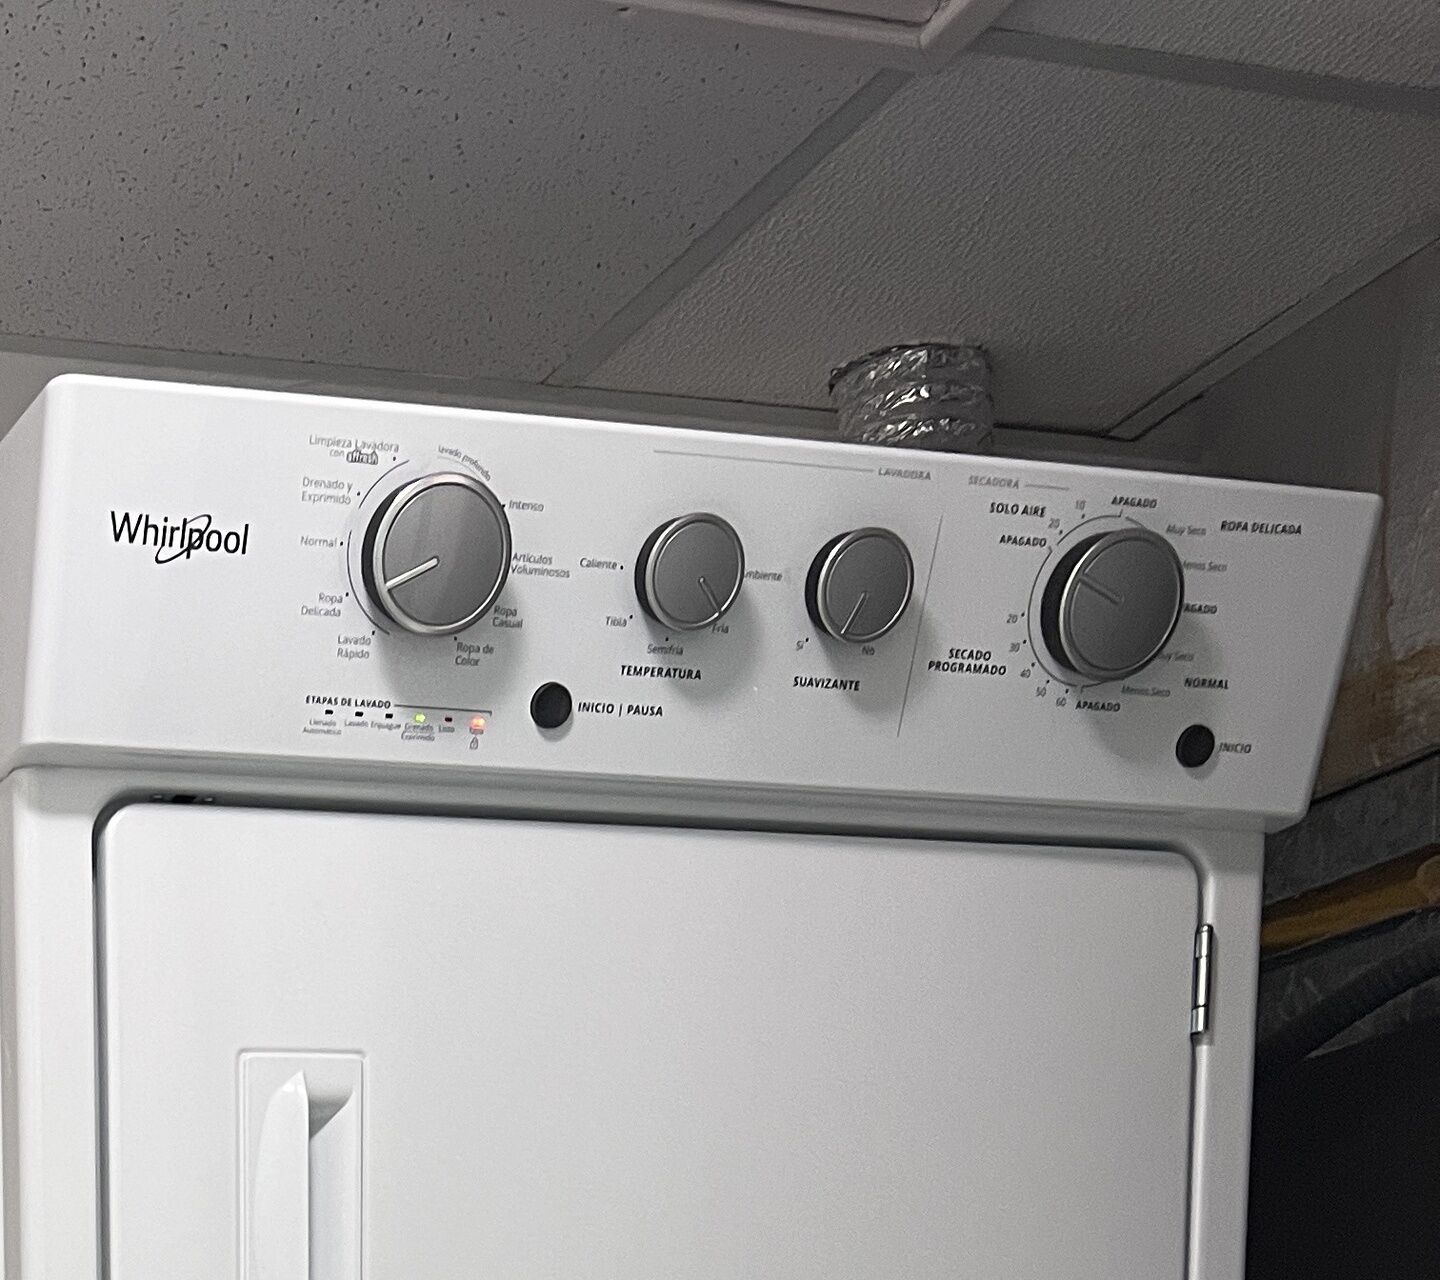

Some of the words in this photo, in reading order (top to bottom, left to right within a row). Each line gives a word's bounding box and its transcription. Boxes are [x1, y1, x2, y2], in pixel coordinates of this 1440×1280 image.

[309, 433, 353, 449] Limpieza
[355, 437, 400, 452] Lavadora
[302, 476, 345, 490] Drenado
[346, 481, 354, 494] y
[968, 475, 1020, 490] SECADORA
[301, 492, 352, 505] Exprimido
[1111, 495, 1158, 509] APAGADO
[509, 500, 545, 512] Intenso
[989, 502, 1020, 516] SOLO
[1021, 504, 1047, 518] AIRE
[1048, 517, 1060, 529] 20
[1220, 520, 1249, 533] ROPA
[1251, 522, 1303, 535] DELICADA
[110, 510, 250, 565] Whirlpool
[300, 535, 338, 548] Normal
[999, 534, 1048, 548] APAGADO
[579, 557, 618, 570] Caliente
[511, 564, 571, 579] Voluminosos
[744, 568, 783, 582] mbiente
[318, 592, 343, 605] Ropa
[300, 606, 342, 617] Delicada
[493, 605, 517, 618] Ropa
[1183, 602, 1218, 615] AGADO
[492, 617, 524, 629] Casual
[1006, 613, 1018, 624] 20
[337, 634, 372, 647] Lavado
[456, 642, 480, 656] Ropa
[482, 643, 495, 654] de
[948, 647, 992, 661] SECADO
[454, 655, 481, 666] Color
[620, 664, 702, 680] TEMPERATURA
[927, 660, 1008, 676] PROGRAMADO
[792, 676, 861, 691] SUAVIZANTE
[1184, 677, 1230, 690] NORMAL
[305, 694, 339, 706] ETAPAS
[340, 696, 353, 707] DE
[354, 698, 391, 709] LAVADO
[1075, 700, 1121, 713] APAGADO
[577, 701, 615, 715] INICIO
[626, 703, 664, 717] PAUSA
[1219, 742, 1253, 754] INICIO
